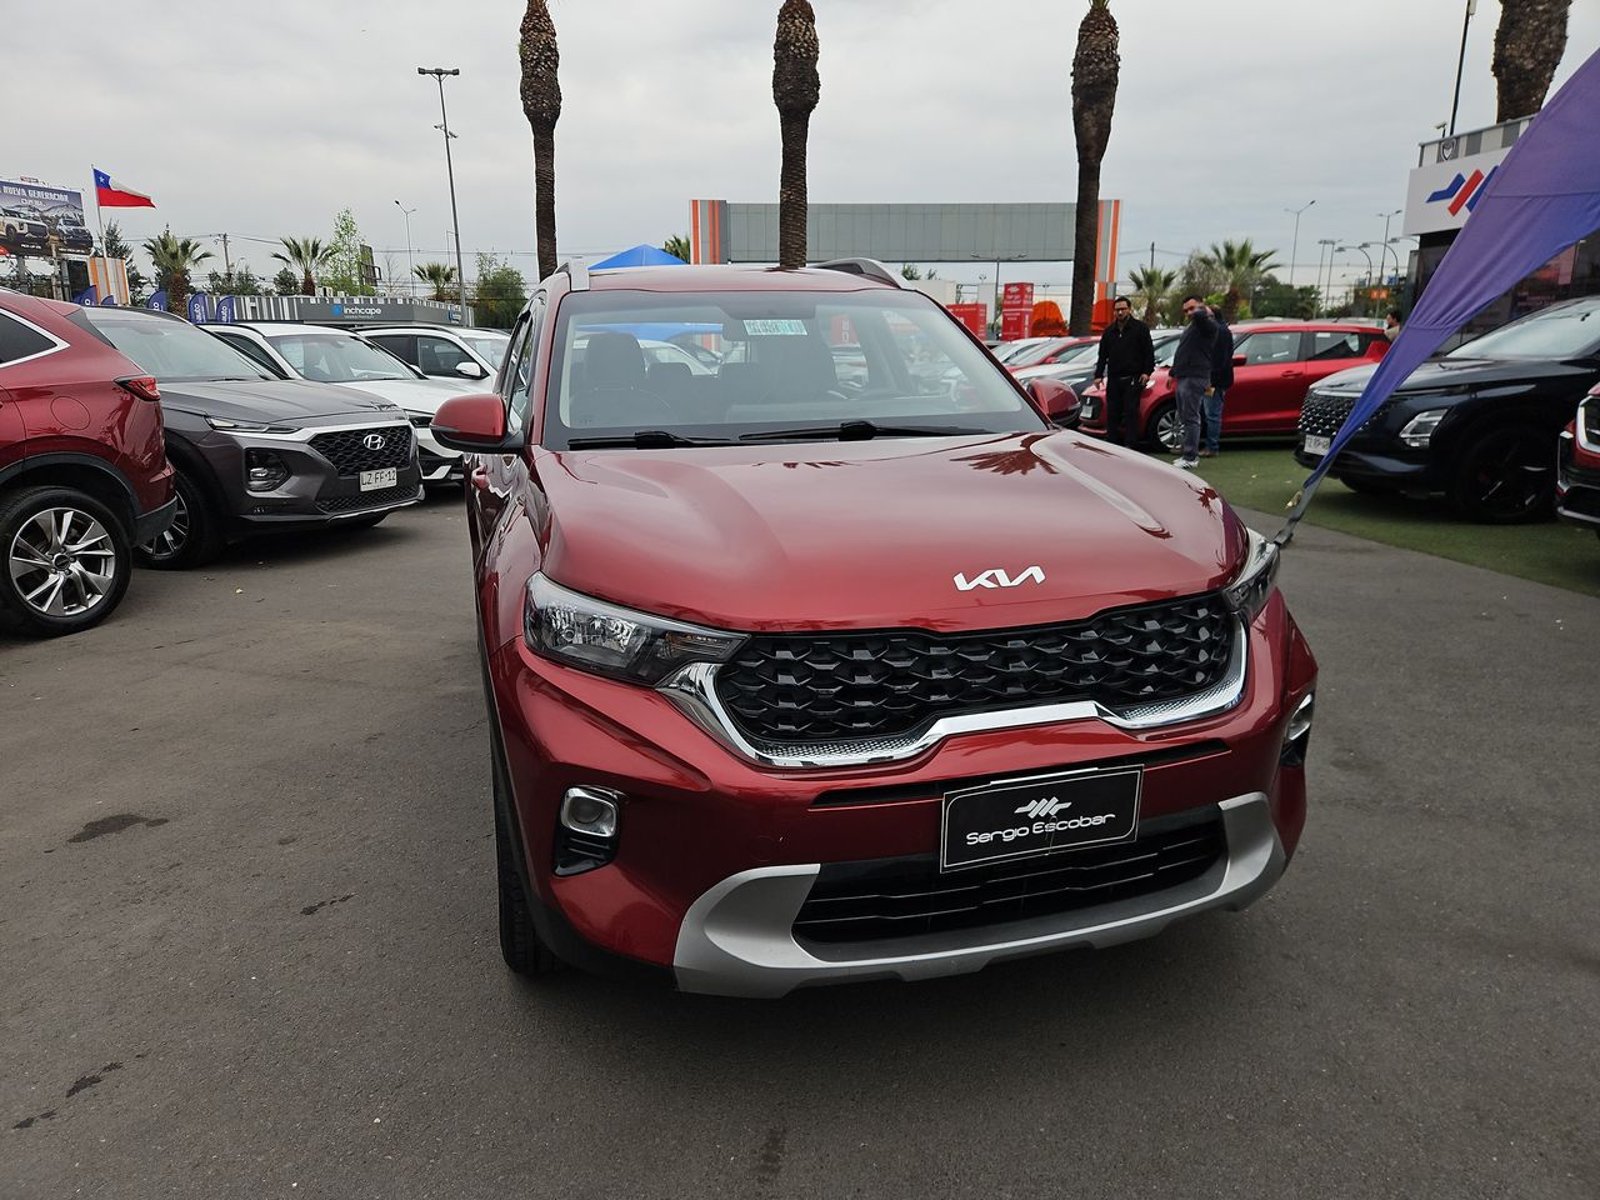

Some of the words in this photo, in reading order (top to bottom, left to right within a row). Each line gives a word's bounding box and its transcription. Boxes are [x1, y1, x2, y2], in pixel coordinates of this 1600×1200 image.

[953, 566, 1046, 591] KIA
[966, 826, 1029, 845] Sergio
[1032, 813, 1116, 834] Escobar
